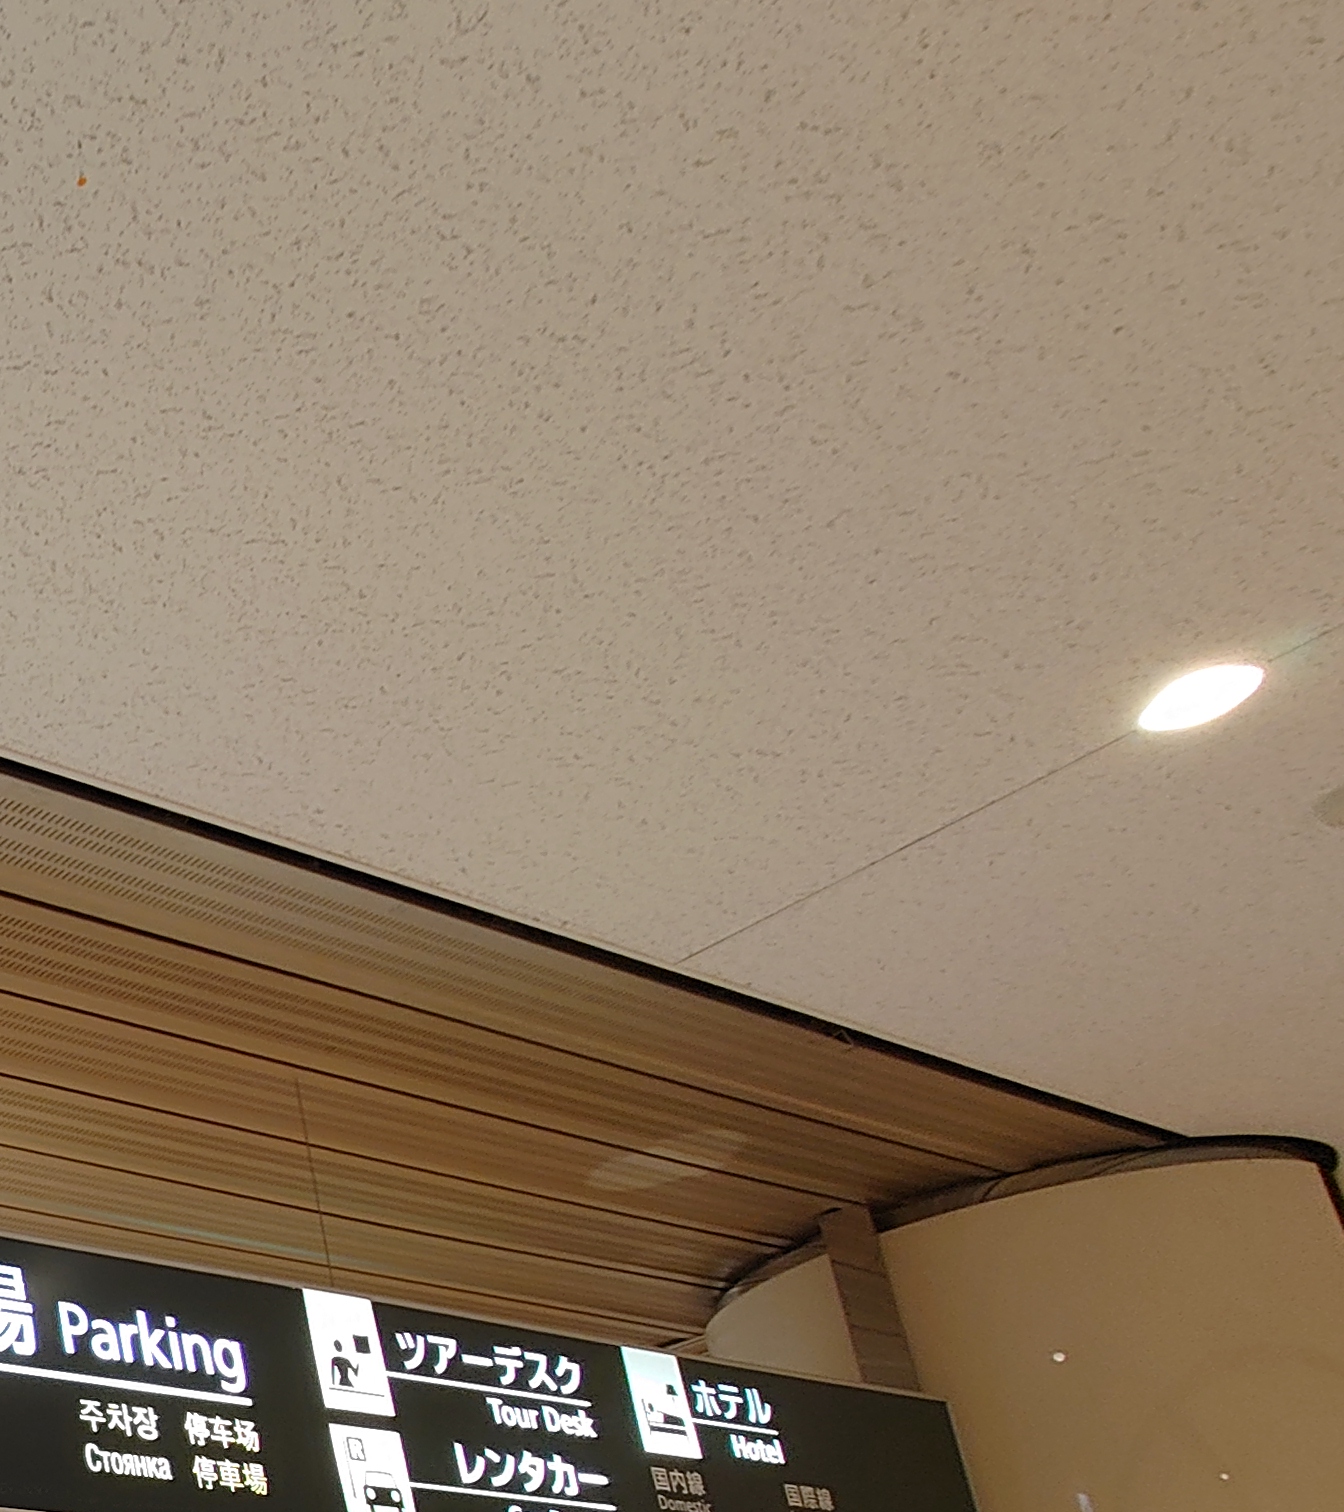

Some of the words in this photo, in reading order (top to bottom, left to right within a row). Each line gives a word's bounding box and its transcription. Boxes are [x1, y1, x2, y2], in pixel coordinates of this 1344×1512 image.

[58, 1300, 250, 1395] Parking
[394, 1331, 584, 1397] ツアーデスク
[78, 1399, 159, 1442] 주차장
[486, 1396, 540, 1433] Tour
[544, 1406, 598, 1440] Desk
[692, 1379, 773, 1427] ホテル
[183, 1410, 261, 1454] 停车场
[729, 1433, 786, 1465] Hotel
[84, 1443, 173, 1483] Стоянка
[191, 1451, 269, 1497] 停車場
[452, 1441, 611, 1499] レンタカー
[650, 1466, 706, 1497] 国内線
